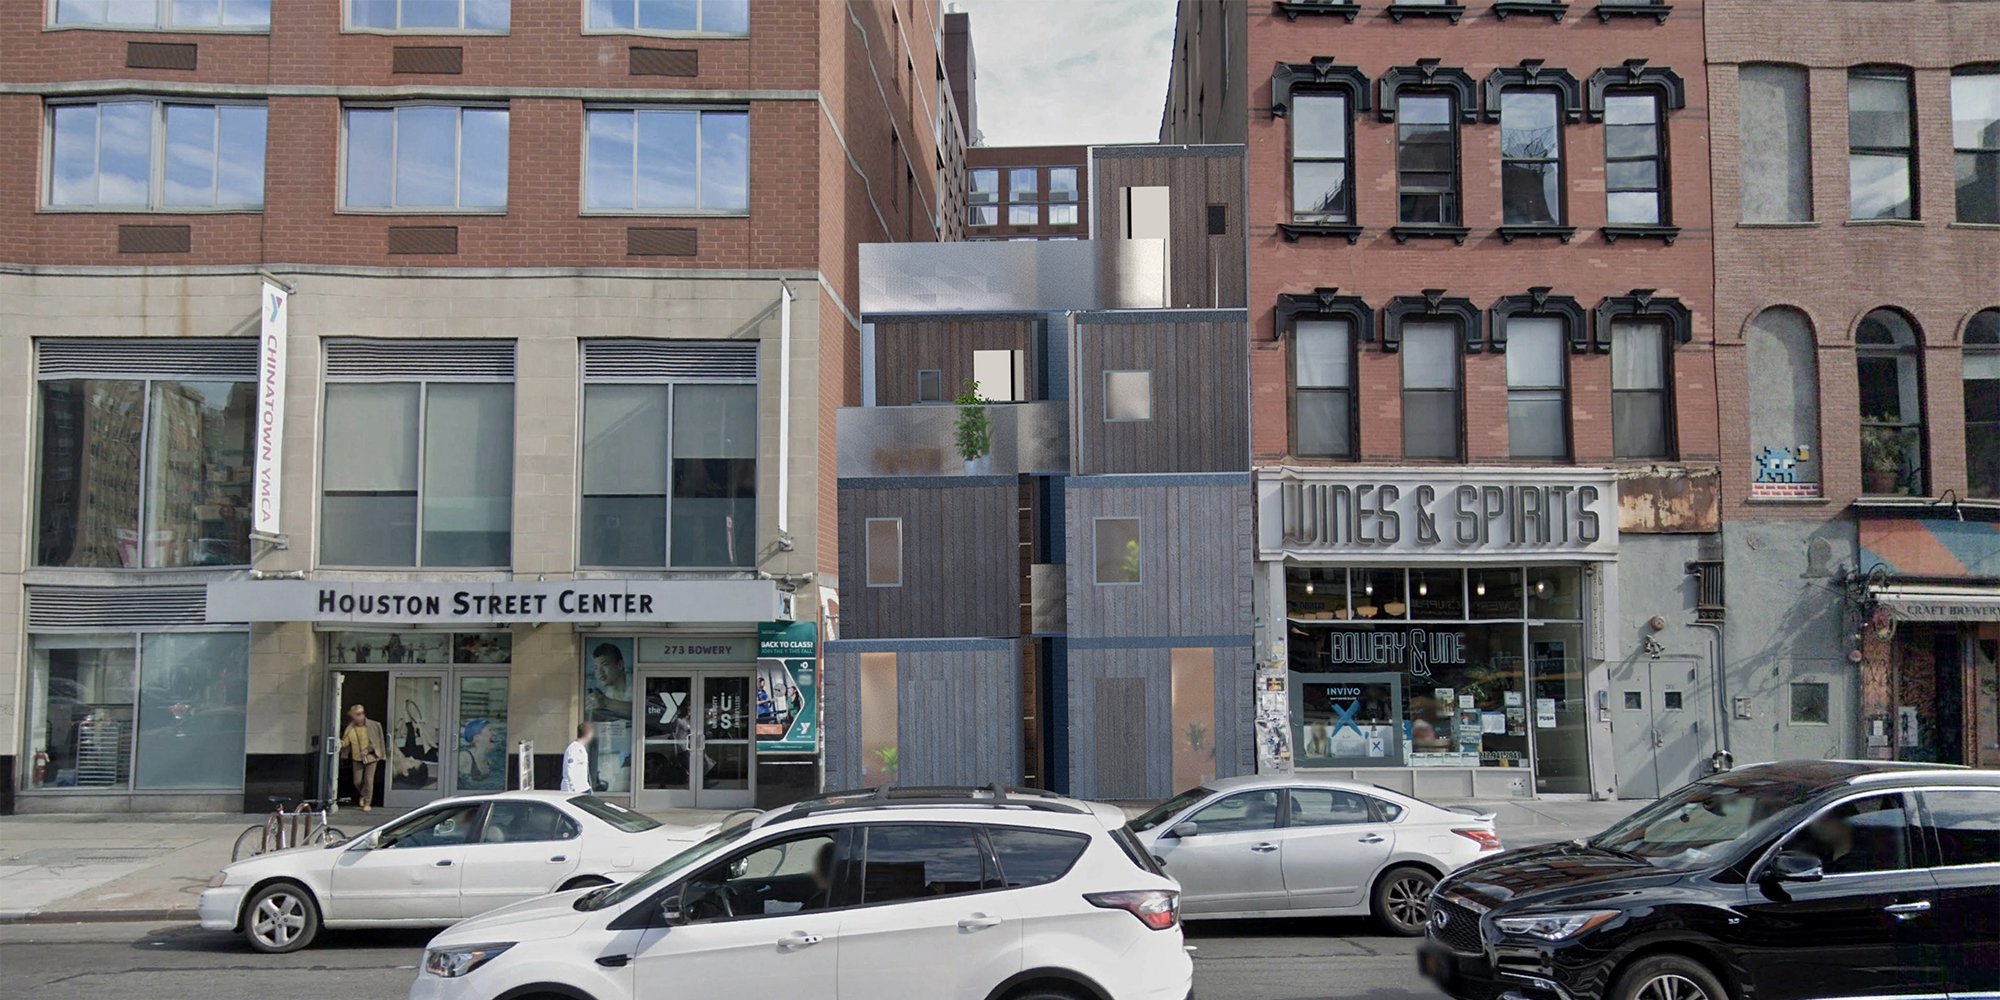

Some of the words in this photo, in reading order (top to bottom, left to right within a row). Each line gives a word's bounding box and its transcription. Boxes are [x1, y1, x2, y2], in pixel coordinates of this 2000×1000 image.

[262, 334, 278, 461] CHINATOWN
[260, 467, 272, 523] YMCA
[1281, 482, 1401, 545] WINES
[1416, 485, 1442, 544] &
[1455, 484, 1600, 544] SPIRITS
[318, 589, 440, 615] HOUSTON
[452, 591, 547, 615] STREET
[558, 589, 654, 614] CENTER
[1907, 605, 1946, 615] CRAFT
[664, 645, 685, 655] 273
[688, 645, 732, 655] BOWERY
[1331, 632, 1406, 664] BOWERY
[1409, 628, 1432, 677] &
[1428, 632, 1467, 664] VINE
[1326, 687, 1361, 696] INVIVO
